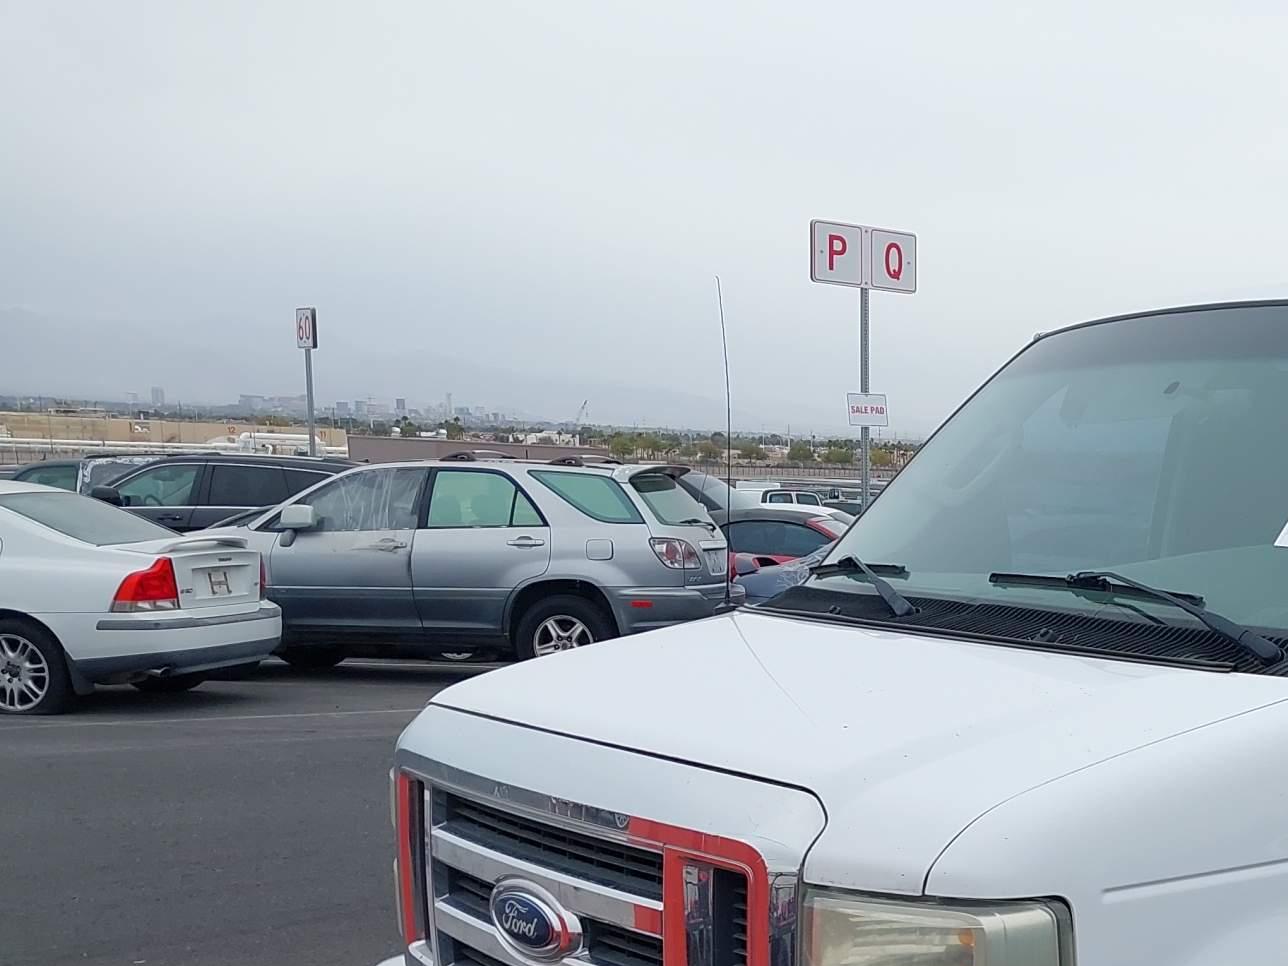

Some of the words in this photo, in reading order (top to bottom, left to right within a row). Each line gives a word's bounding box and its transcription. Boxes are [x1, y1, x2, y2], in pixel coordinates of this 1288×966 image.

[828, 234, 847, 271] P
[884, 242, 904, 281] Q
[850, 405, 869, 415] SALE
[870, 406, 885, 416] PAD
[502, 900, 538, 939] Ford
